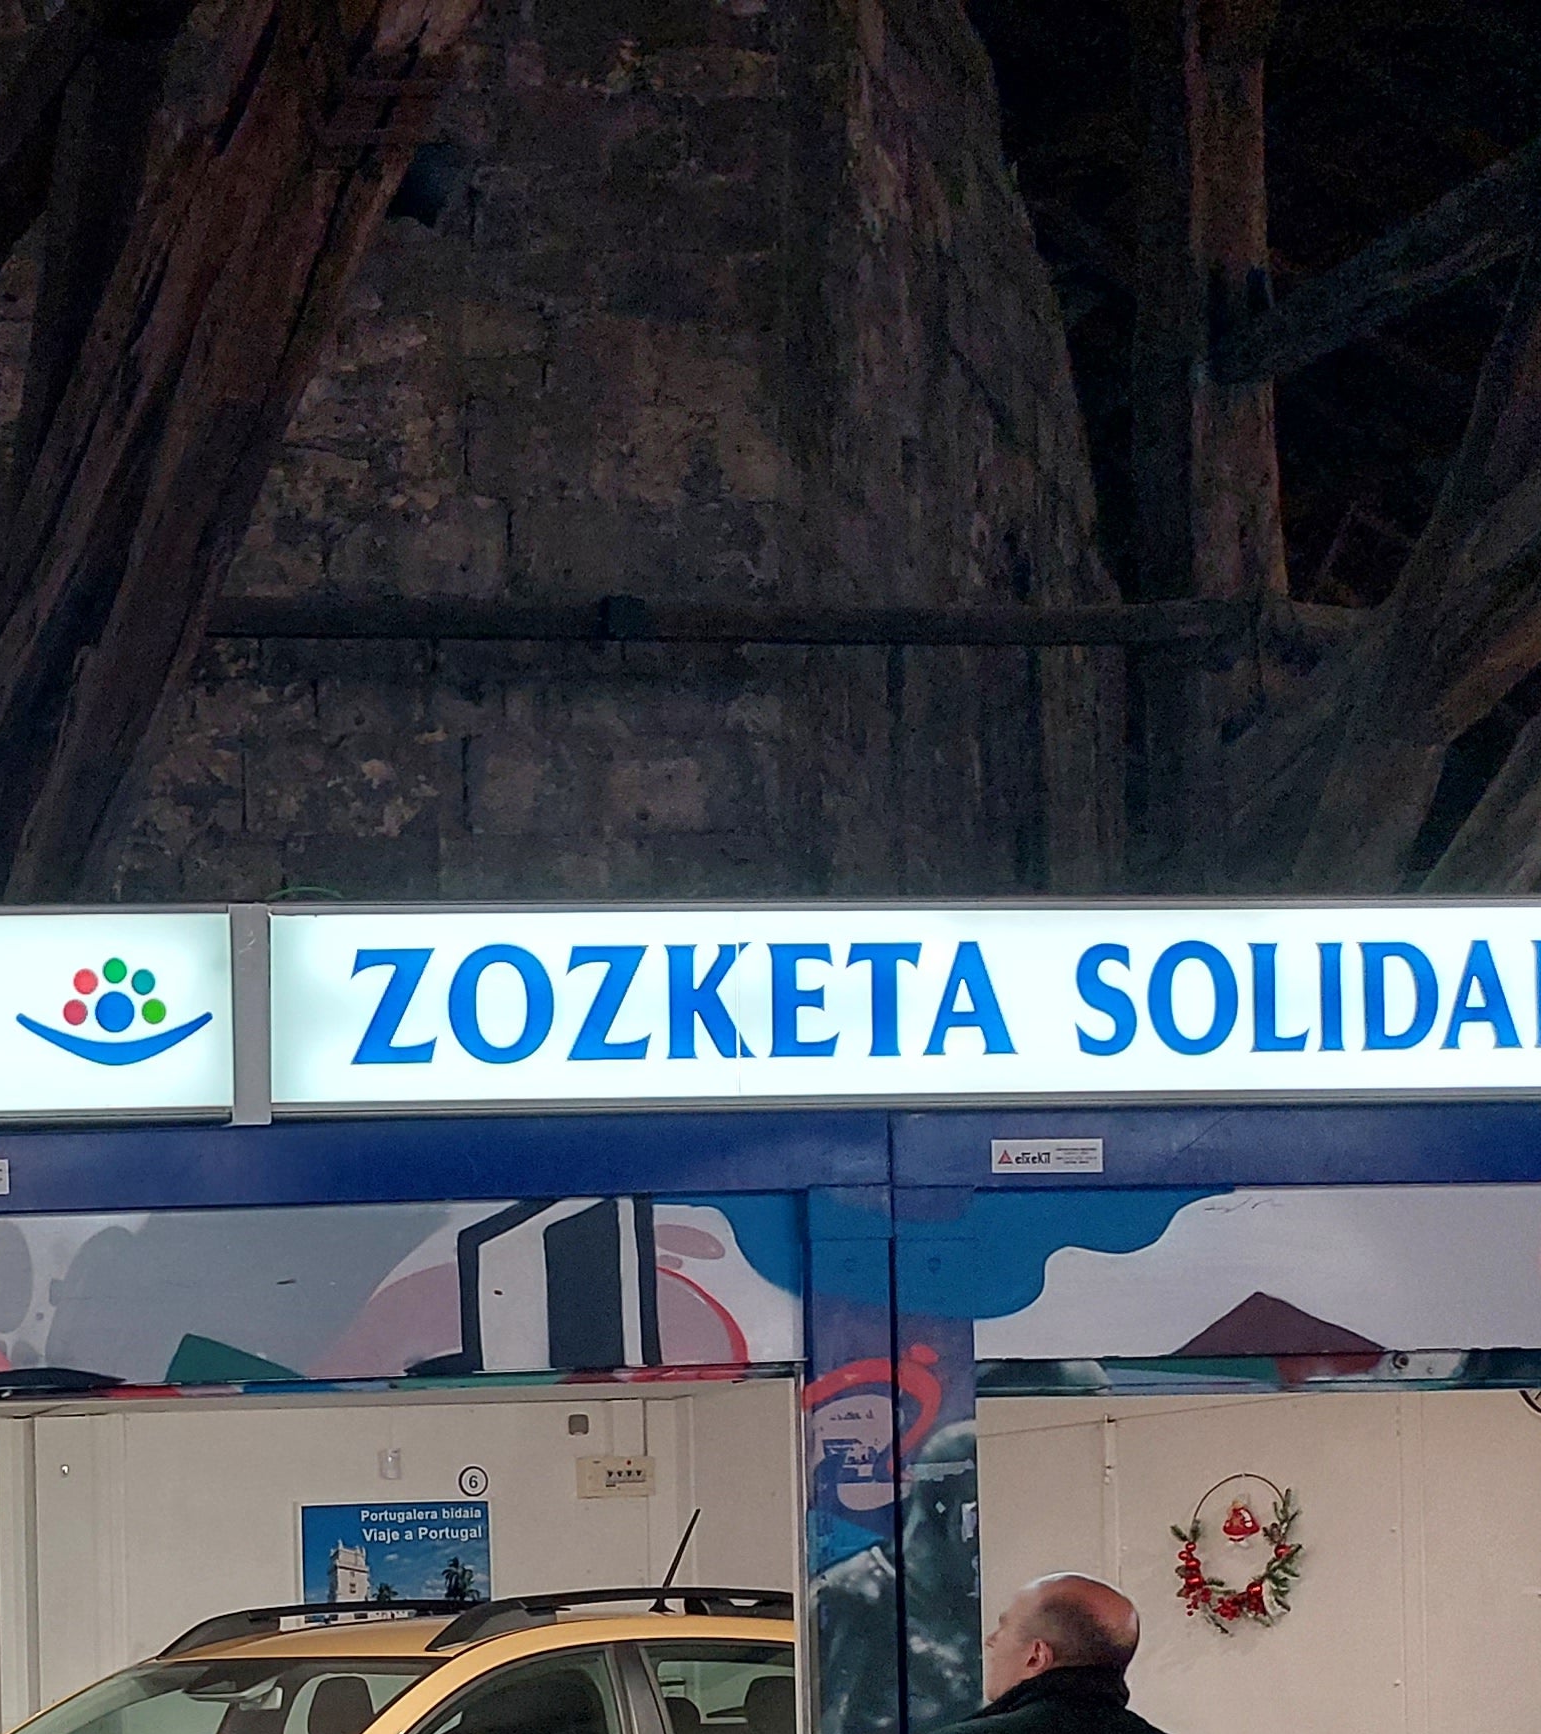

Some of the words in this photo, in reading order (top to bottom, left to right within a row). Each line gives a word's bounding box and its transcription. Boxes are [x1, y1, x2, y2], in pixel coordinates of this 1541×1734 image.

[351, 941, 1018, 1066] ZOZKETA
[1076, 939, 1541, 1058] SOLIDA
[469, 1475, 478, 1489] 6
[361, 1508, 438, 1523] Portugalera
[442, 1507, 482, 1520] bidaia
[362, 1528, 400, 1544] Viaje
[404, 1530, 414, 1541] a
[418, 1526, 482, 1542] Portugal
